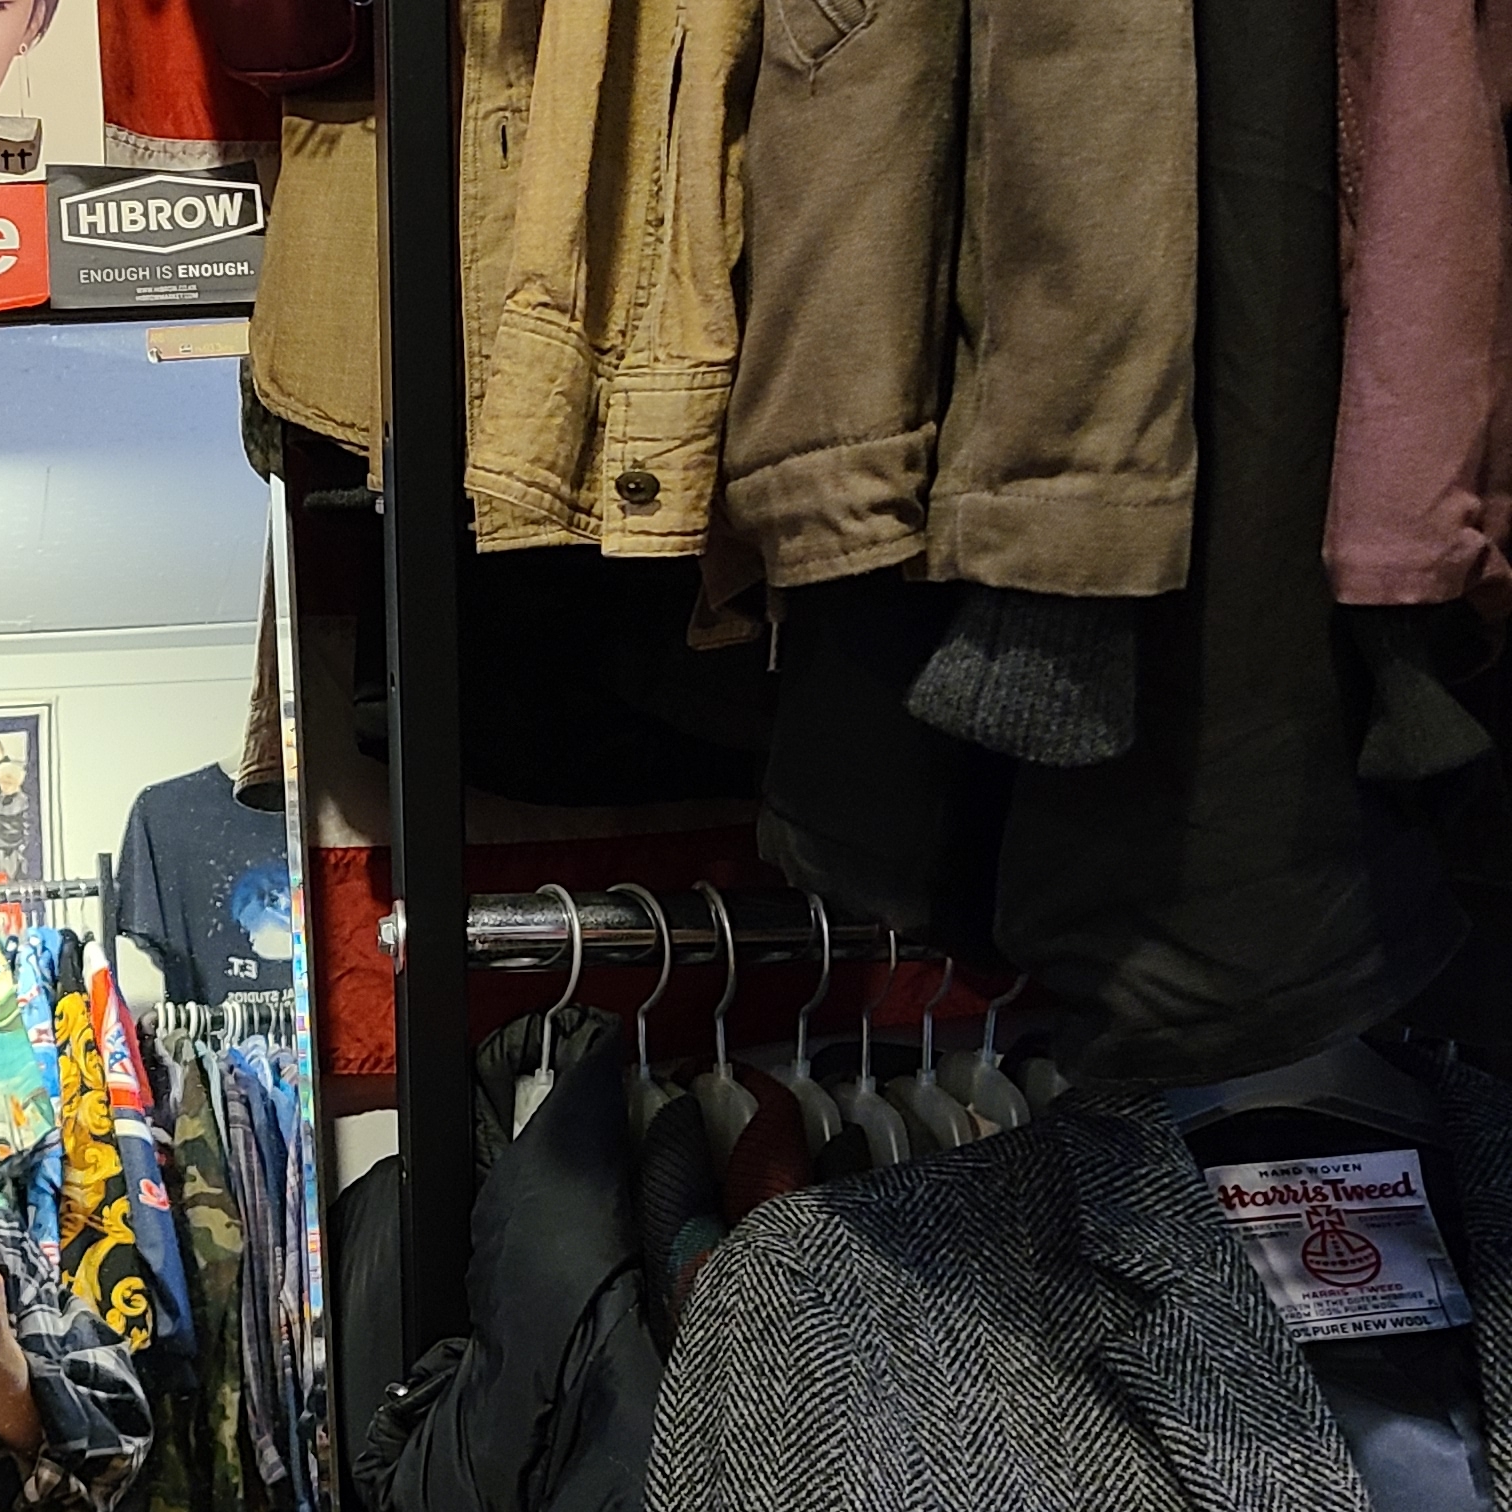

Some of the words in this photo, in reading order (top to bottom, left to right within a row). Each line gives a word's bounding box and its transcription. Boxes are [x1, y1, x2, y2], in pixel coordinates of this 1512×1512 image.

[77, 192, 243, 235] HIBROW
[79, 267, 150, 284] ENOUGH
[156, 265, 173, 280] IS
[177, 262, 255, 279] ENOUGH.
[1259, 1166, 1302, 1179] HAND
[1307, 1162, 1362, 1176] WOVEN
[1218, 1179, 1324, 1210] Harris
[1322, 1171, 1418, 1202] Tweed
[1351, 1318, 1387, 1333] NEW
[1389, 1315, 1431, 1329] WOOL
